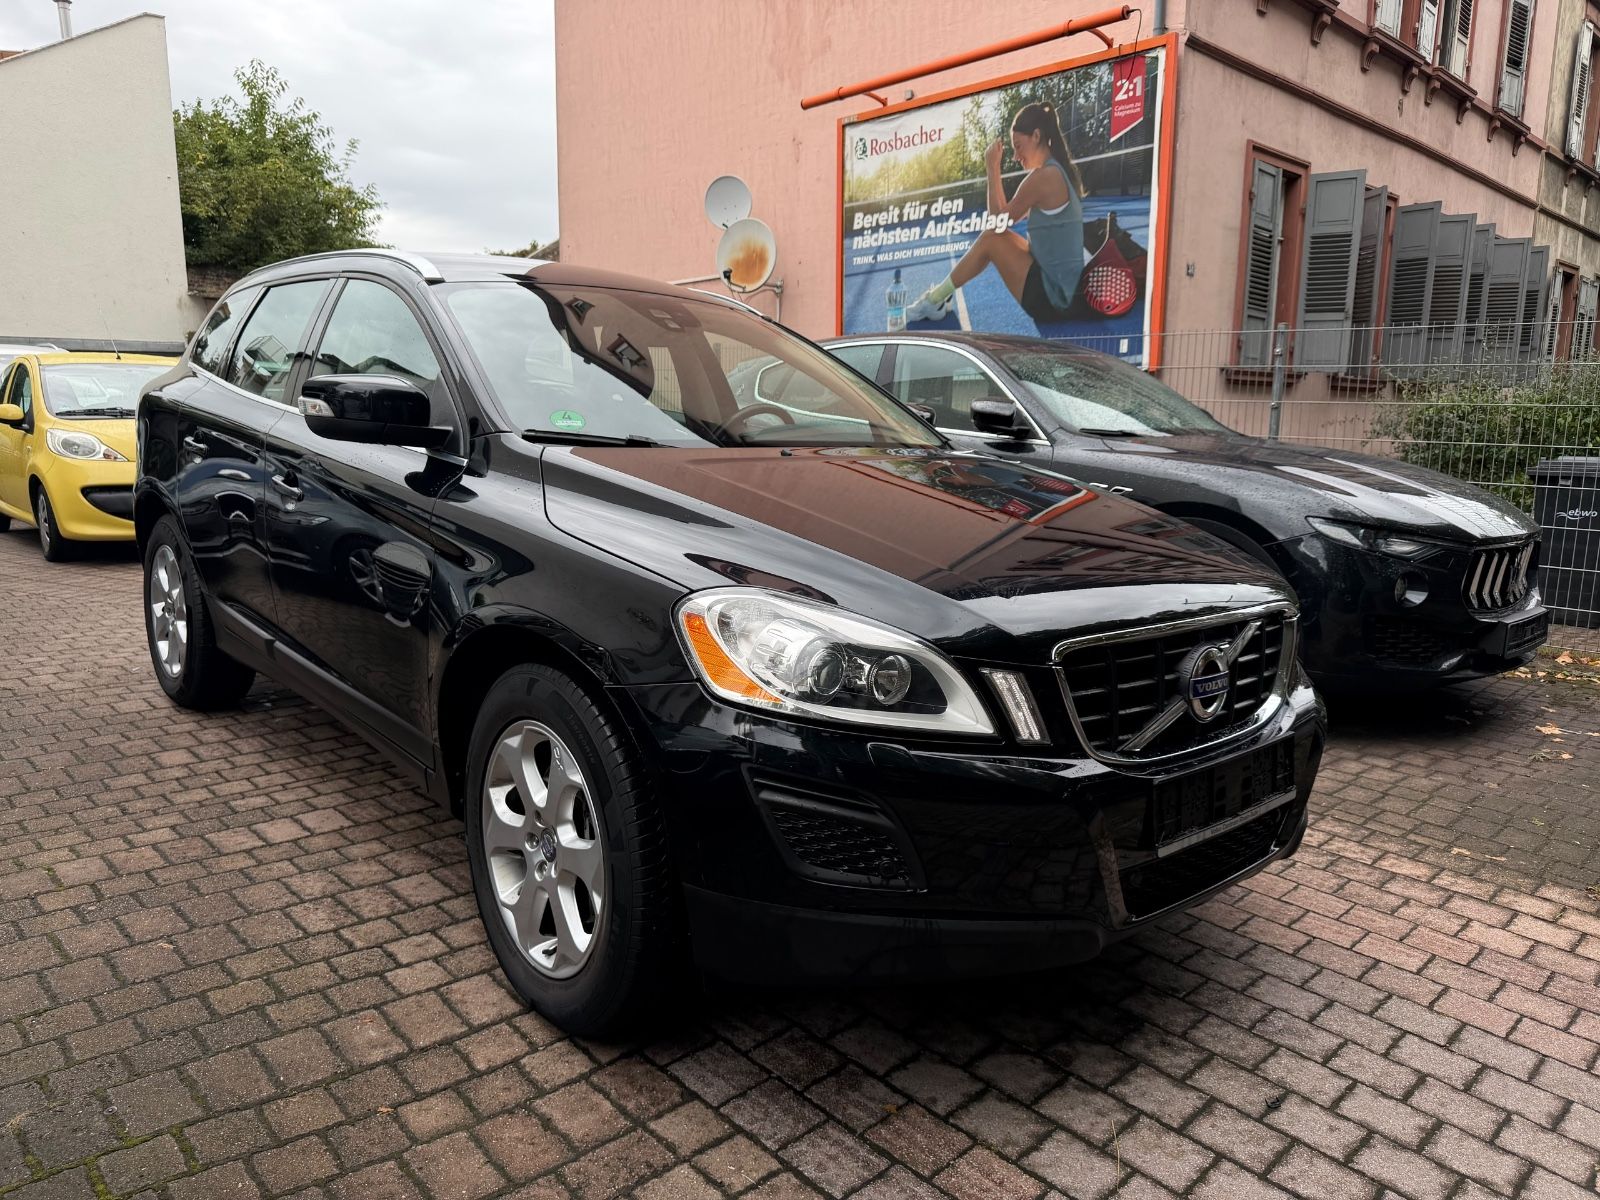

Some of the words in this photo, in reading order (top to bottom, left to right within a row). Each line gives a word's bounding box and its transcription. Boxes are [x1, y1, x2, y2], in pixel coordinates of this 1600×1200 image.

[1114, 75, 1143, 102] 2:1
[870, 125, 945, 157] Rosbacher
[852, 205, 900, 230] Bereit
[902, 200, 928, 222] für
[930, 196, 964, 217] den
[852, 226, 921, 250] nächsten
[922, 210, 1014, 239] Aufschlag.
[852, 256, 876, 266] TRINK,
[877, 252, 894, 262] WAS
[893, 249, 912, 260] DICH
[913, 241, 973, 258] WEITERBRINGT.
[1568, 507, 1598, 518] ebwo
[1195, 677, 1228, 693] VOLVO
